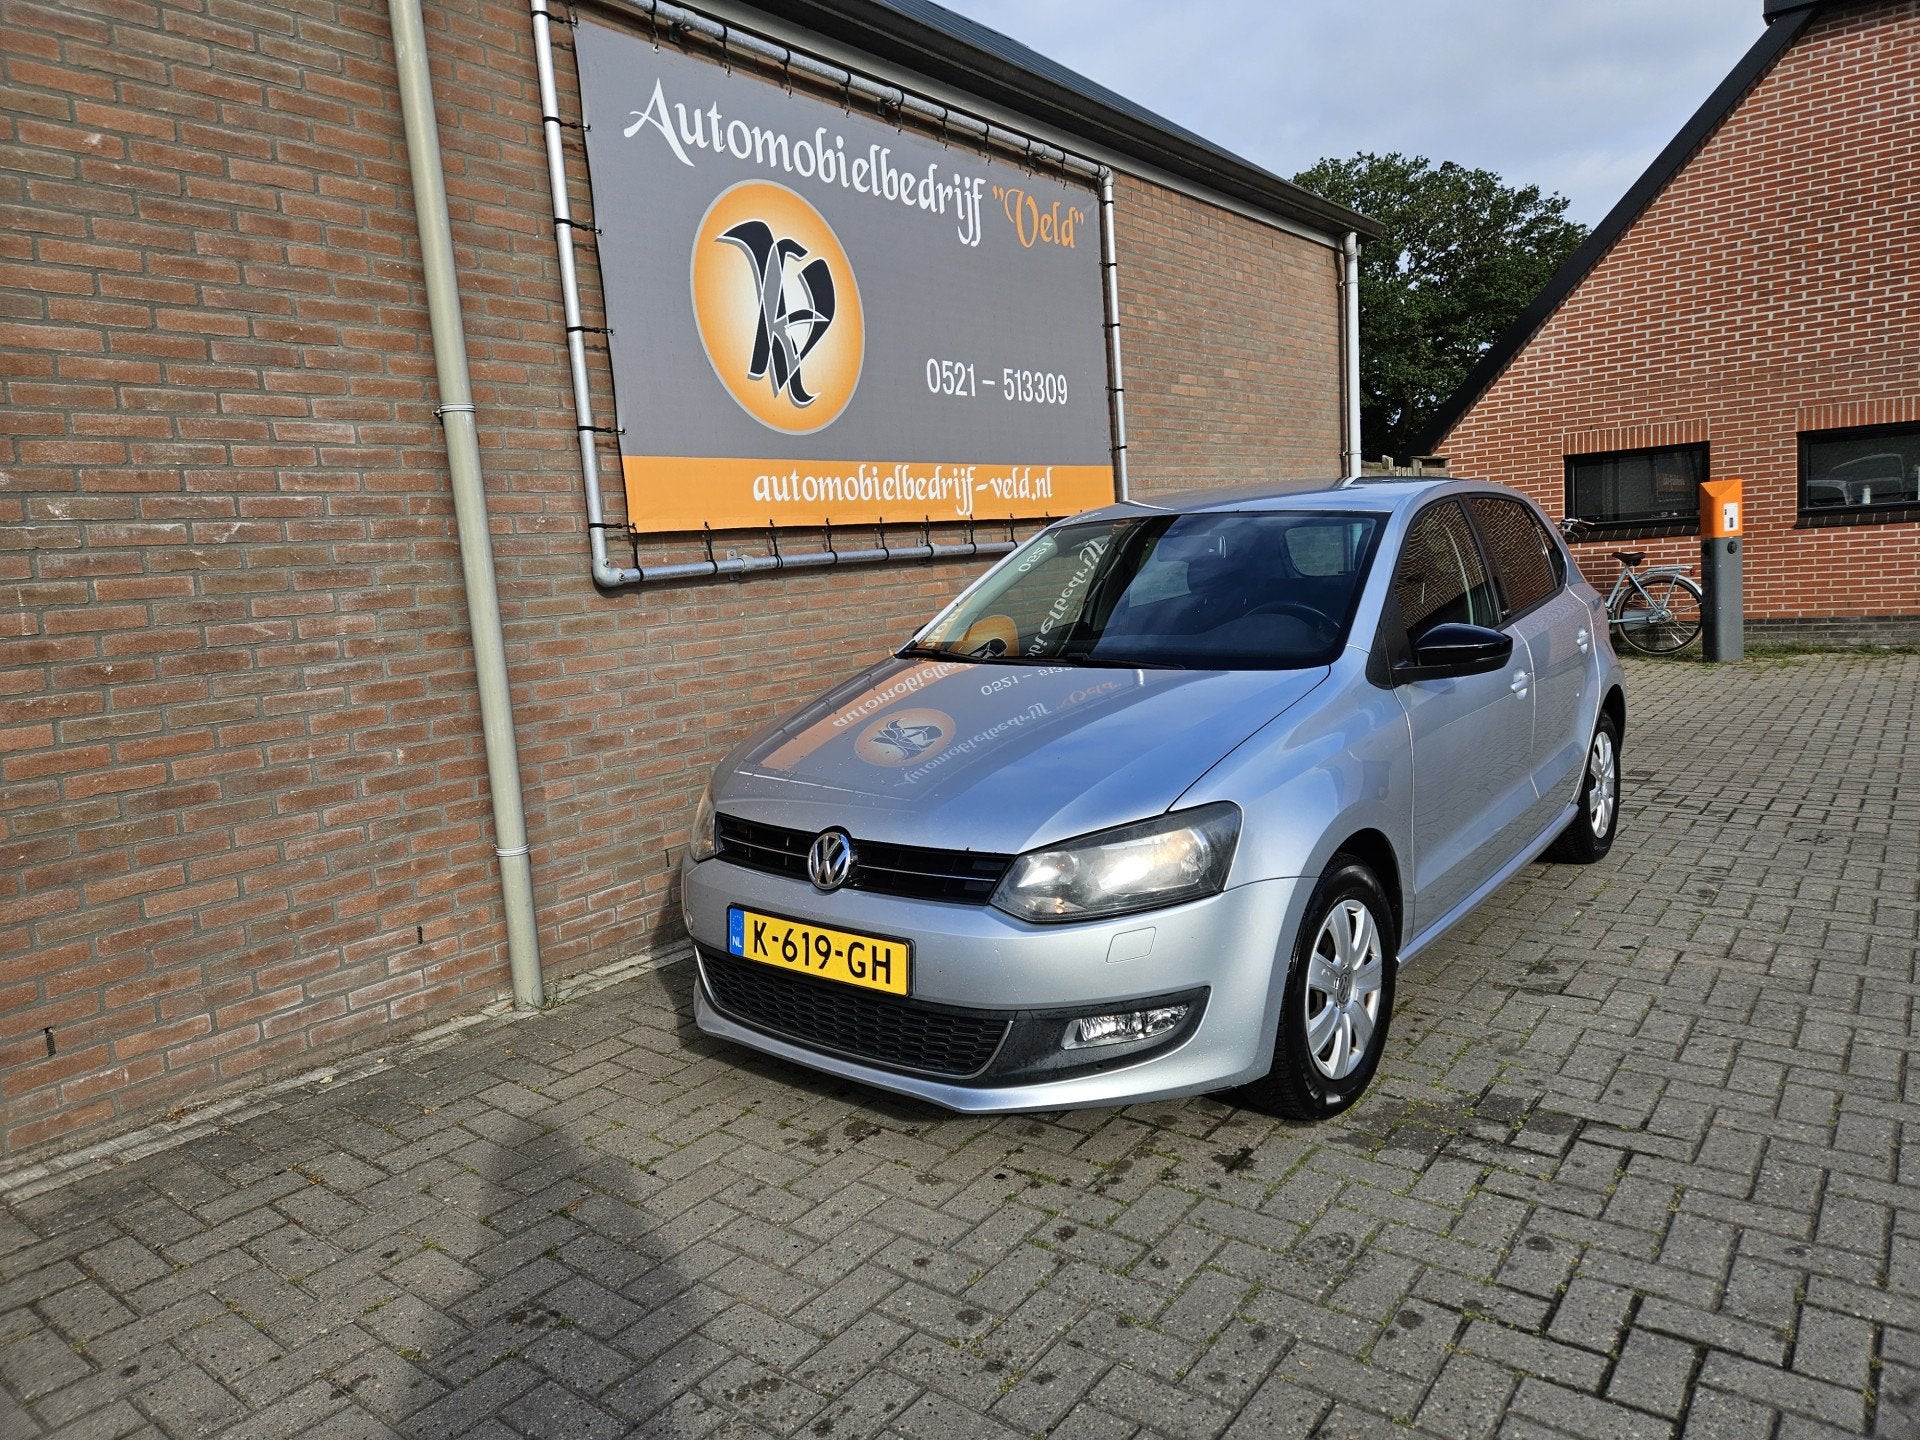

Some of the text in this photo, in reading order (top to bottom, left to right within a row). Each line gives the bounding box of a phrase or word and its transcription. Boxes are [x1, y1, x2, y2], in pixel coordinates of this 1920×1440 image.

[623, 77, 986, 247] Automobielbedrijf
[926, 358, 976, 397] 0521
[1003, 368, 1068, 405] 513309
[752, 463, 1054, 516] automobielbedrijf-veld.nl
[732, 935, 743, 948] NL
[753, 920, 891, 985] K-619-GH
